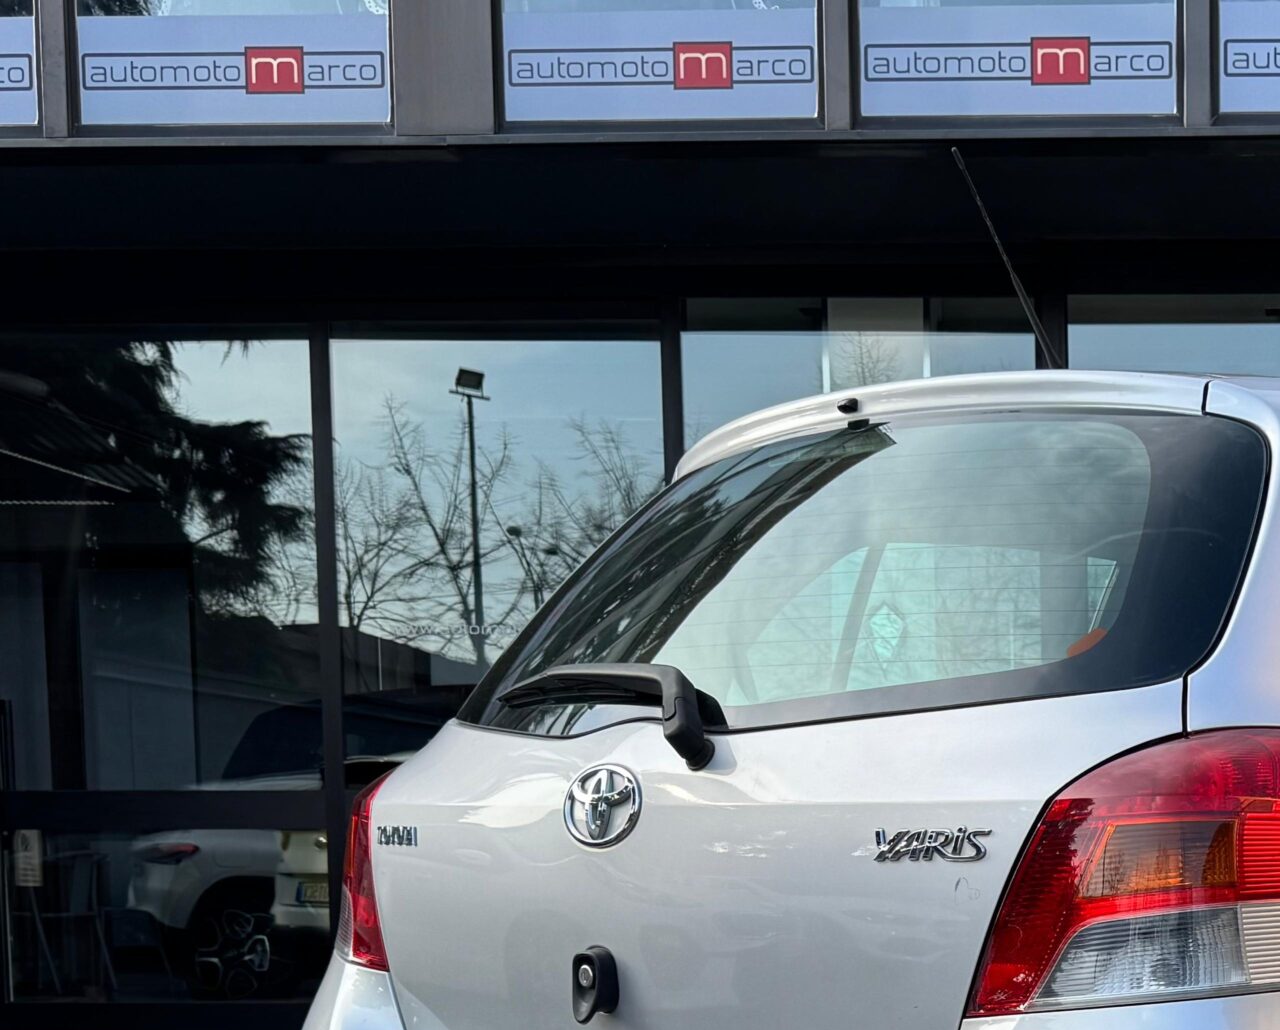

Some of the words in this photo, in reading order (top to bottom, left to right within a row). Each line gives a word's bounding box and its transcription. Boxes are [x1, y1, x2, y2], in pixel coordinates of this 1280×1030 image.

[90, 60, 241, 83] automoto
[516, 56, 669, 80] automoto
[872, 51, 1026, 75] automoto
